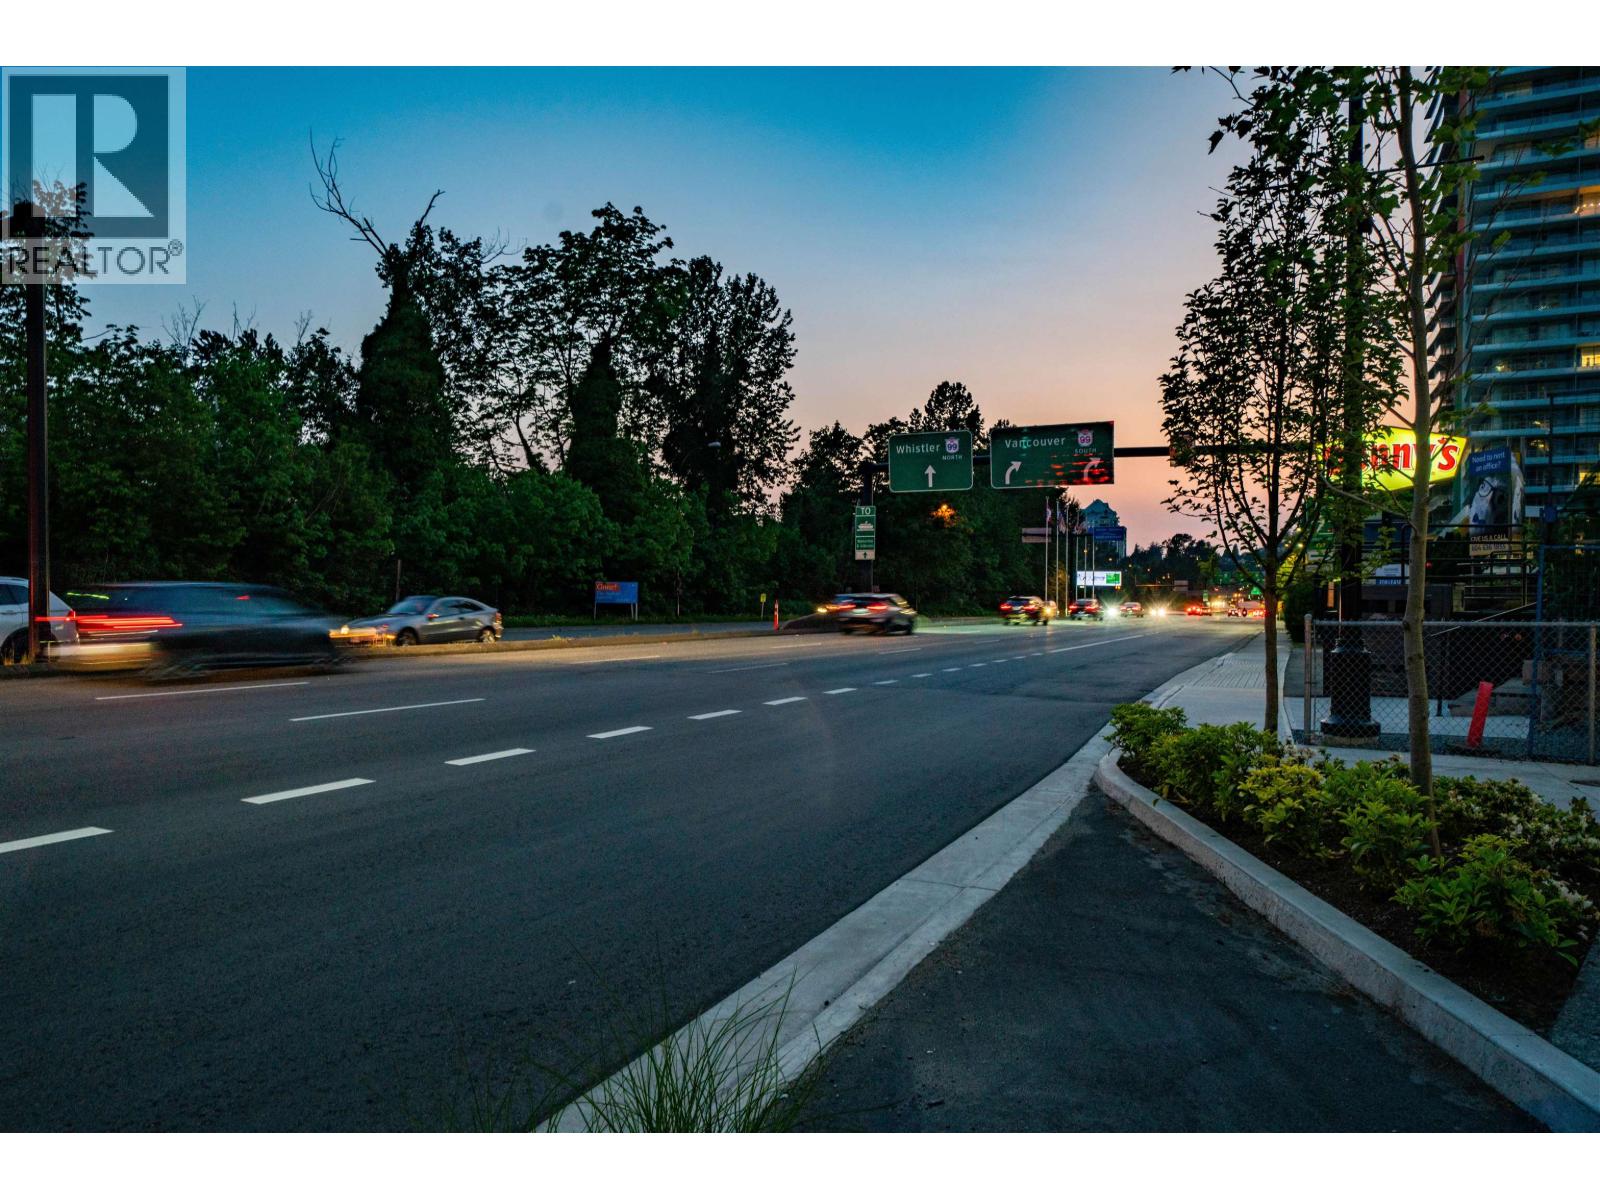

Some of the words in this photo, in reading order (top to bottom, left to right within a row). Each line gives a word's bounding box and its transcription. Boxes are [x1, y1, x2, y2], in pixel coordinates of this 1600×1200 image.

[1004, 437, 1066, 449] Vancouver
[1079, 436, 1091, 444] 99
[896, 443, 941, 454] Whistler
[947, 443, 958, 451] 99
[861, 507, 871, 515] TO
